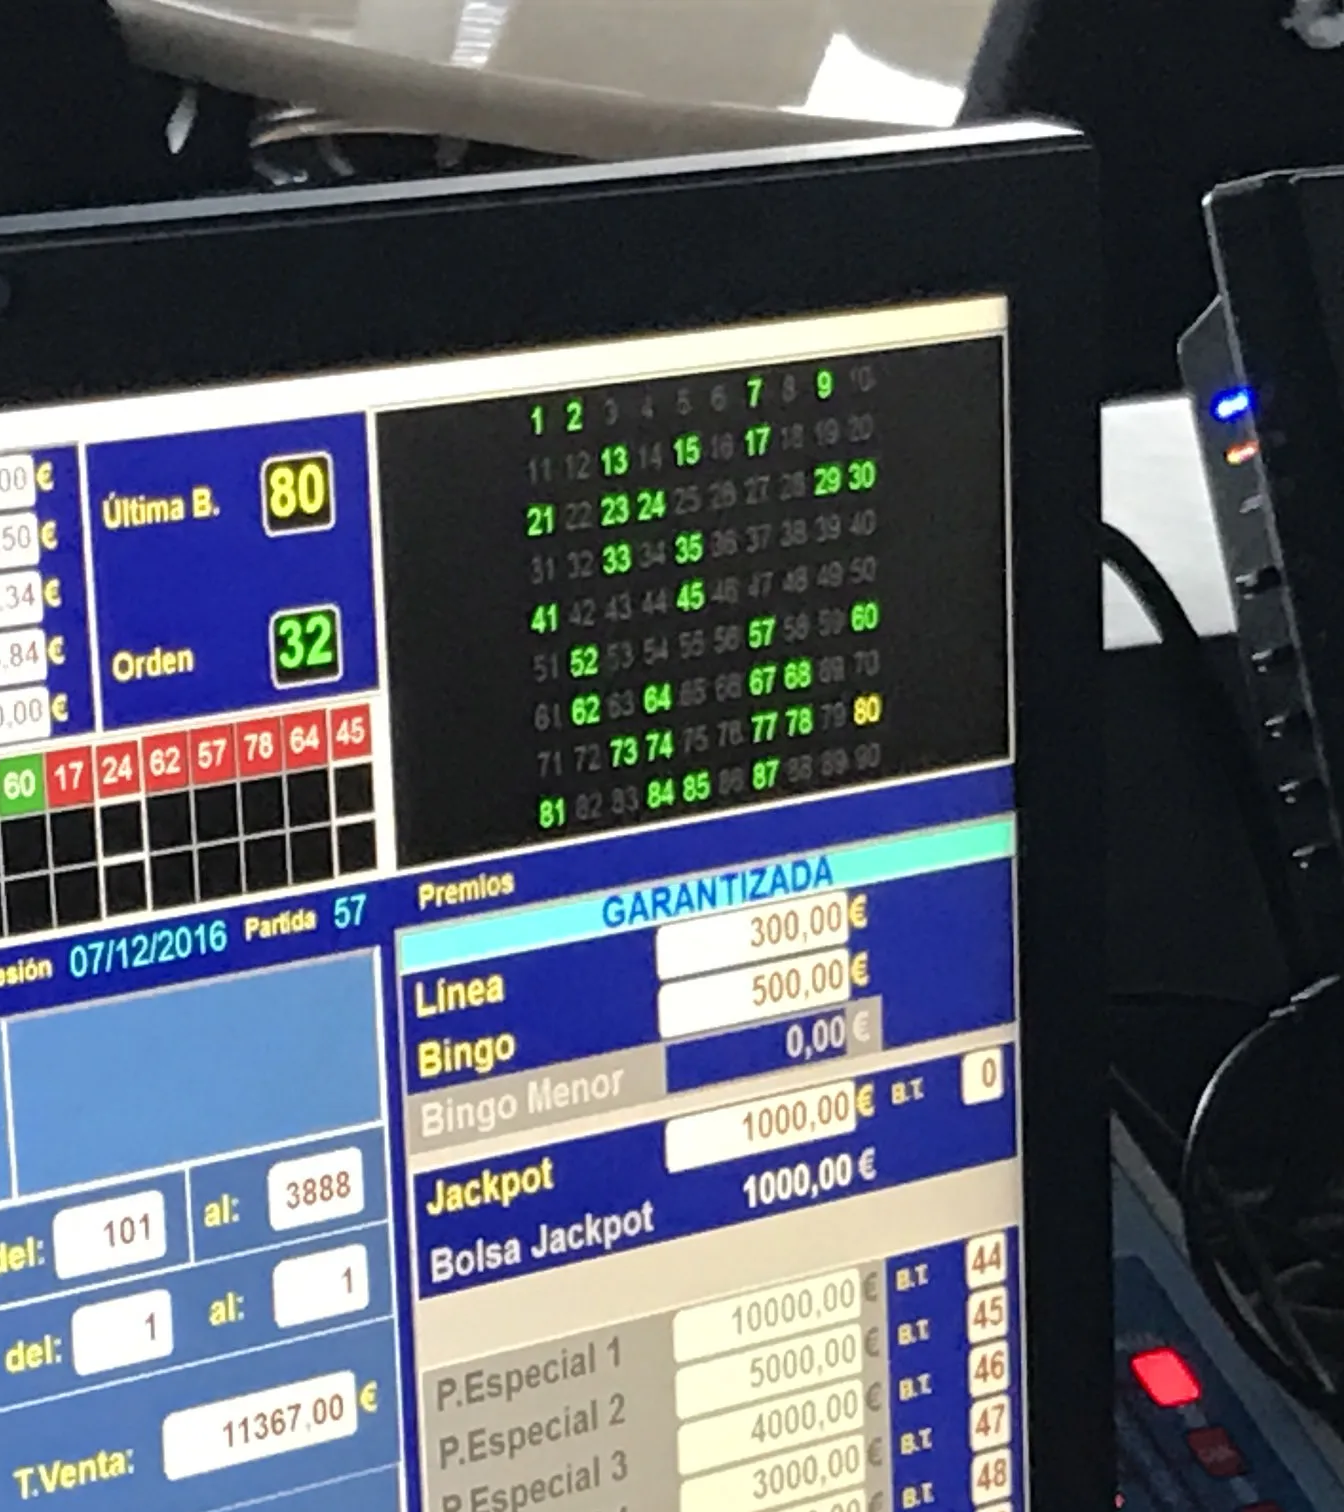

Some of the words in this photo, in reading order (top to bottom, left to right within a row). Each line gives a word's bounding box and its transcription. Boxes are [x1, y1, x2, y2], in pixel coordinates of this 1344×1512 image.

[747, 379, 762, 405] 7
[817, 370, 832, 398] 9
[102, 488, 185, 530] Última
[192, 487, 221, 518] B.
[268, 471, 325, 517] 80
[673, 435, 701, 467] 15
[848, 460, 876, 490] 30
[527, 504, 554, 536] 21
[112, 645, 195, 682] Orden
[278, 618, 334, 668] 32
[748, 616, 775, 648] 57
[854, 694, 881, 726] 80
[54, 762, 85, 791] 17
[335, 718, 366, 747] 45
[418, 872, 515, 910] Premios
[602, 855, 835, 929] GARANTIZADA
[69, 921, 229, 979] 07/12/2016
[244, 906, 318, 942] Partida
[333, 897, 368, 931] 57
[414, 972, 505, 1018] Línea
[750, 900, 843, 949] 300,00
[418, 1031, 516, 1079] Bingo
[751, 957, 845, 1007] 500,00
[420, 1090, 518, 1139] Bingo
[527, 1065, 625, 1114] Menor
[786, 1014, 846, 1060] 0,00
[426, 1156, 554, 1217] Jackpot
[742, 1090, 850, 1143] 1000,00
[103, 1215, 152, 1249] 101
[203, 1194, 240, 1229] al:
[285, 1170, 352, 1208] 3888
[430, 1233, 521, 1285] Bolsa
[531, 1199, 655, 1261] Jackpot
[742, 1153, 853, 1210] 1000,00
[4, 1333, 63, 1373] del:
[210, 1292, 245, 1326] al:
[435, 1344, 597, 1413] P.Especial
[609, 1336, 623, 1368] 1
[731, 1275, 856, 1338] 10000,00
[971, 1241, 1003, 1274] 44
[438, 1402, 600, 1471] P.Especial
[608, 1392, 626, 1426] 2
[749, 1332, 857, 1389] 5000,00
[972, 1296, 1005, 1328] 45
